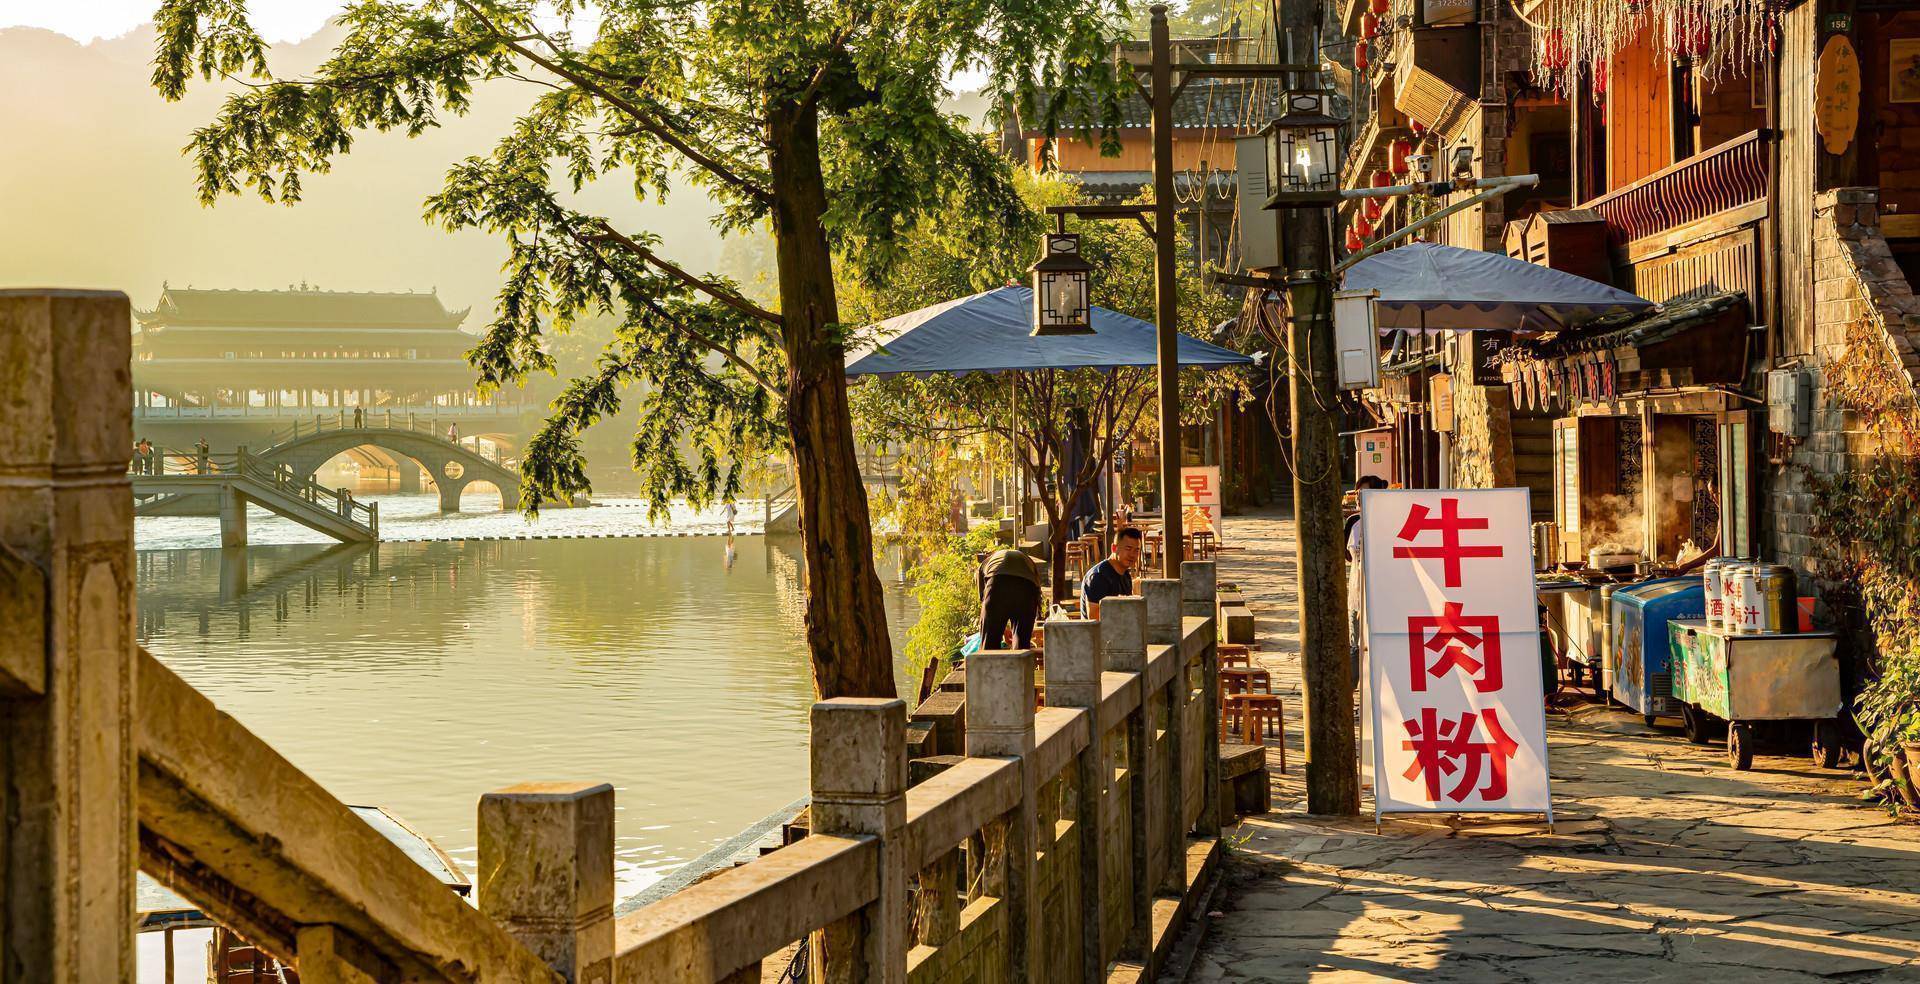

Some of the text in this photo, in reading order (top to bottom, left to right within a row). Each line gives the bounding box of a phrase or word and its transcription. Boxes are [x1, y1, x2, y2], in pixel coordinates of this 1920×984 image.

[1831, 20, 1847, 29] 156
[1393, 498, 1519, 803] 牛肉粉
